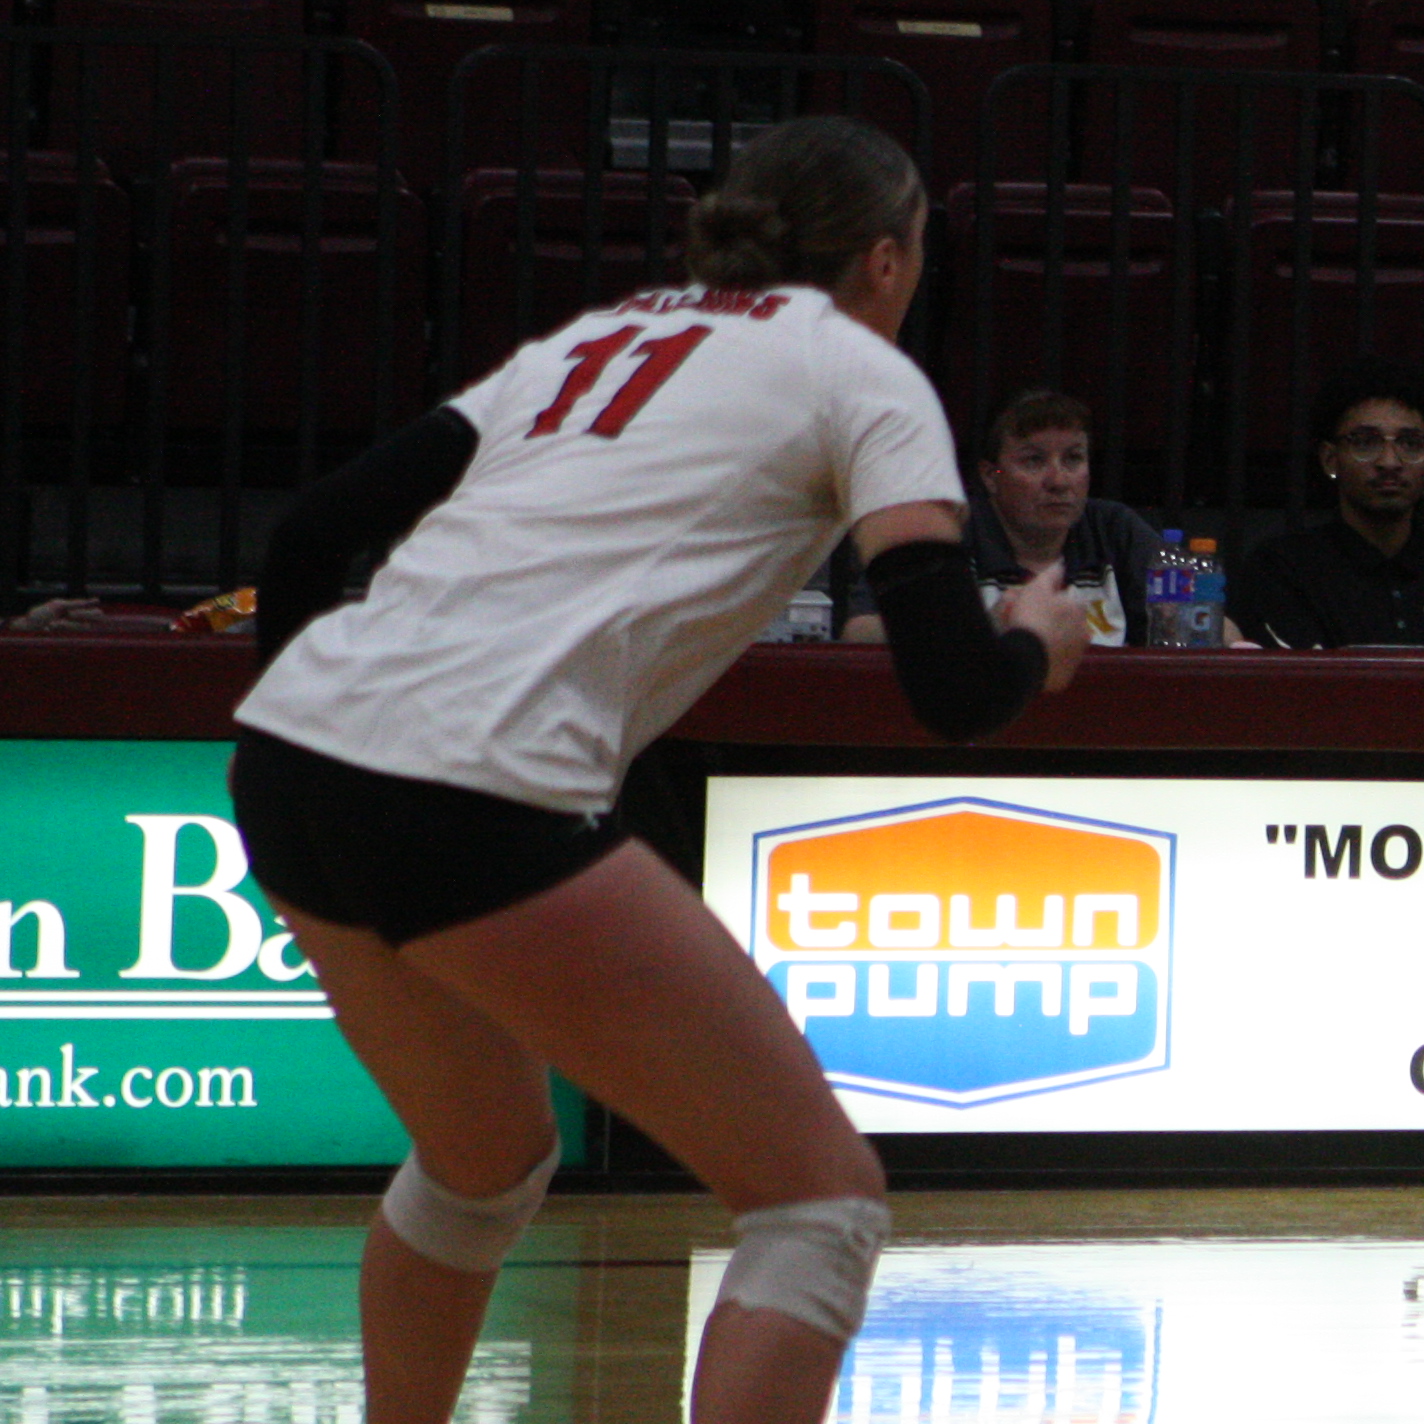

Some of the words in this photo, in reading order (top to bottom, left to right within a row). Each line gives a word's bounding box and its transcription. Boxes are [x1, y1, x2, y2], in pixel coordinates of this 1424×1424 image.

[523, 324, 714, 440] 11
[777, 872, 1140, 949] town
[786, 962, 1140, 1036] pump
